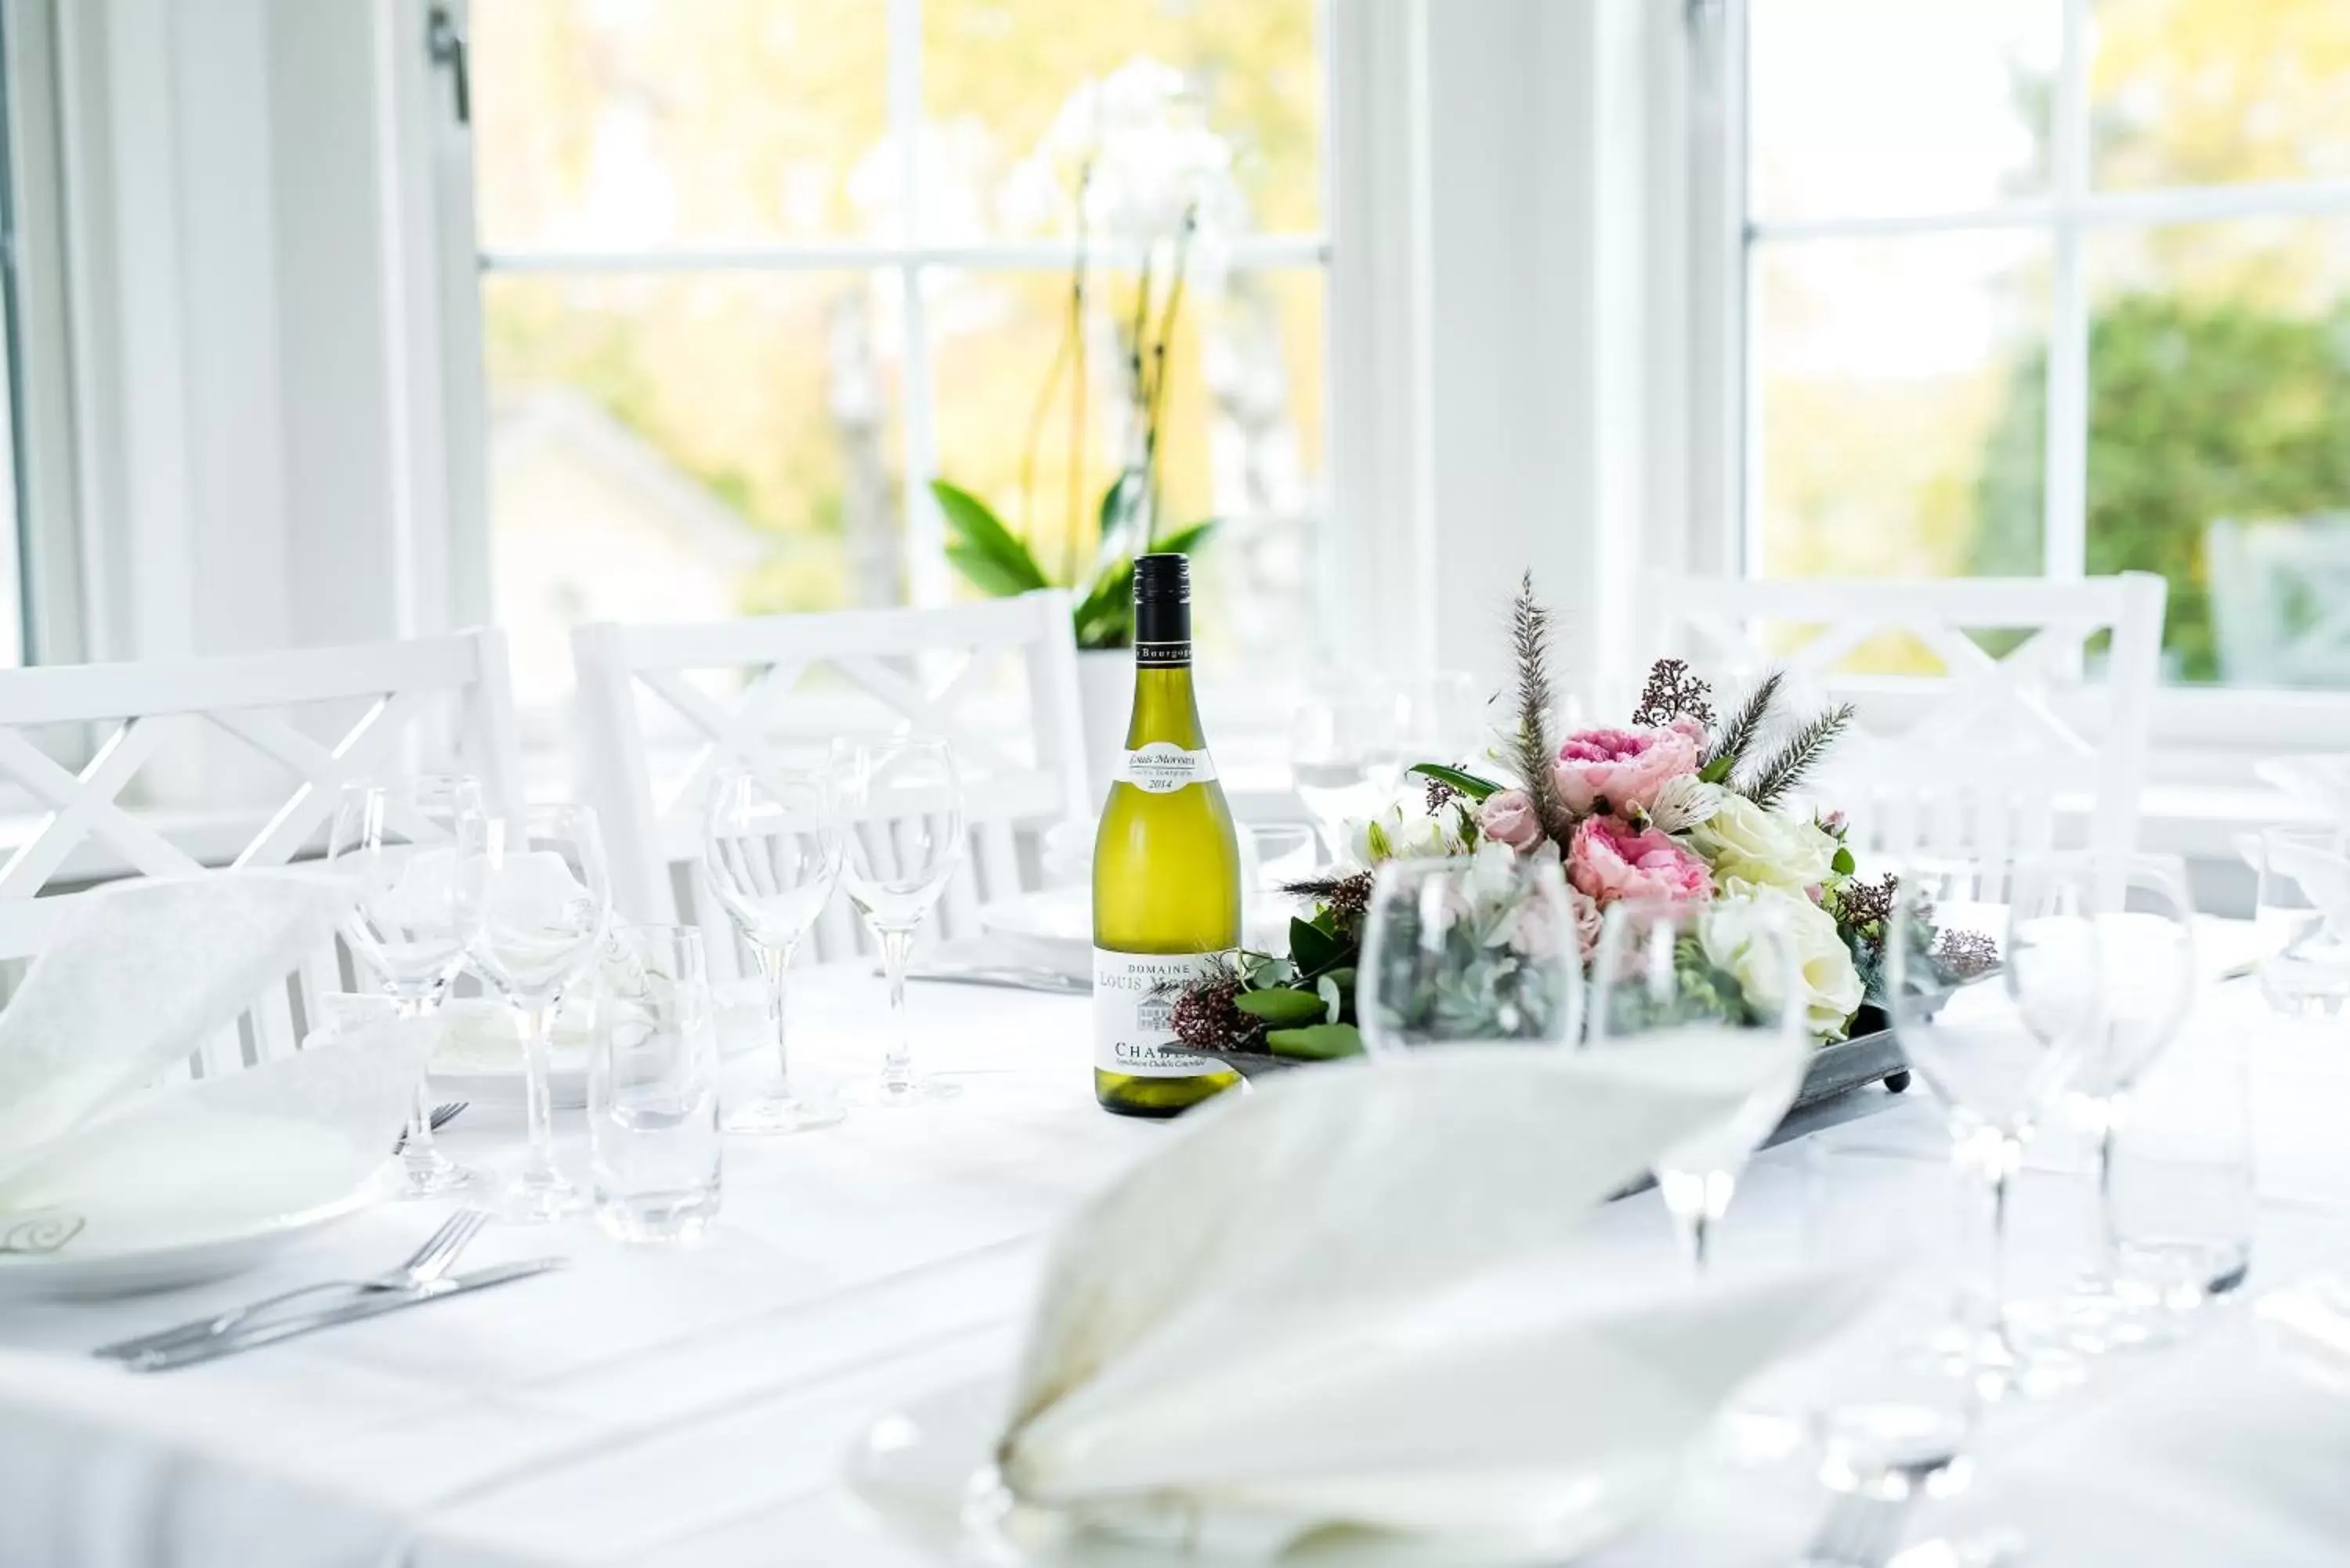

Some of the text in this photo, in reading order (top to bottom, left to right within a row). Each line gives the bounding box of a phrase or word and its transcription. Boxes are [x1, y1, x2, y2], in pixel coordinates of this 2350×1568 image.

[1148, 779, 1173, 789] 2014
[1128, 964, 1190, 974] DOMAINE
[1100, 971, 1141, 990] LOUIS
